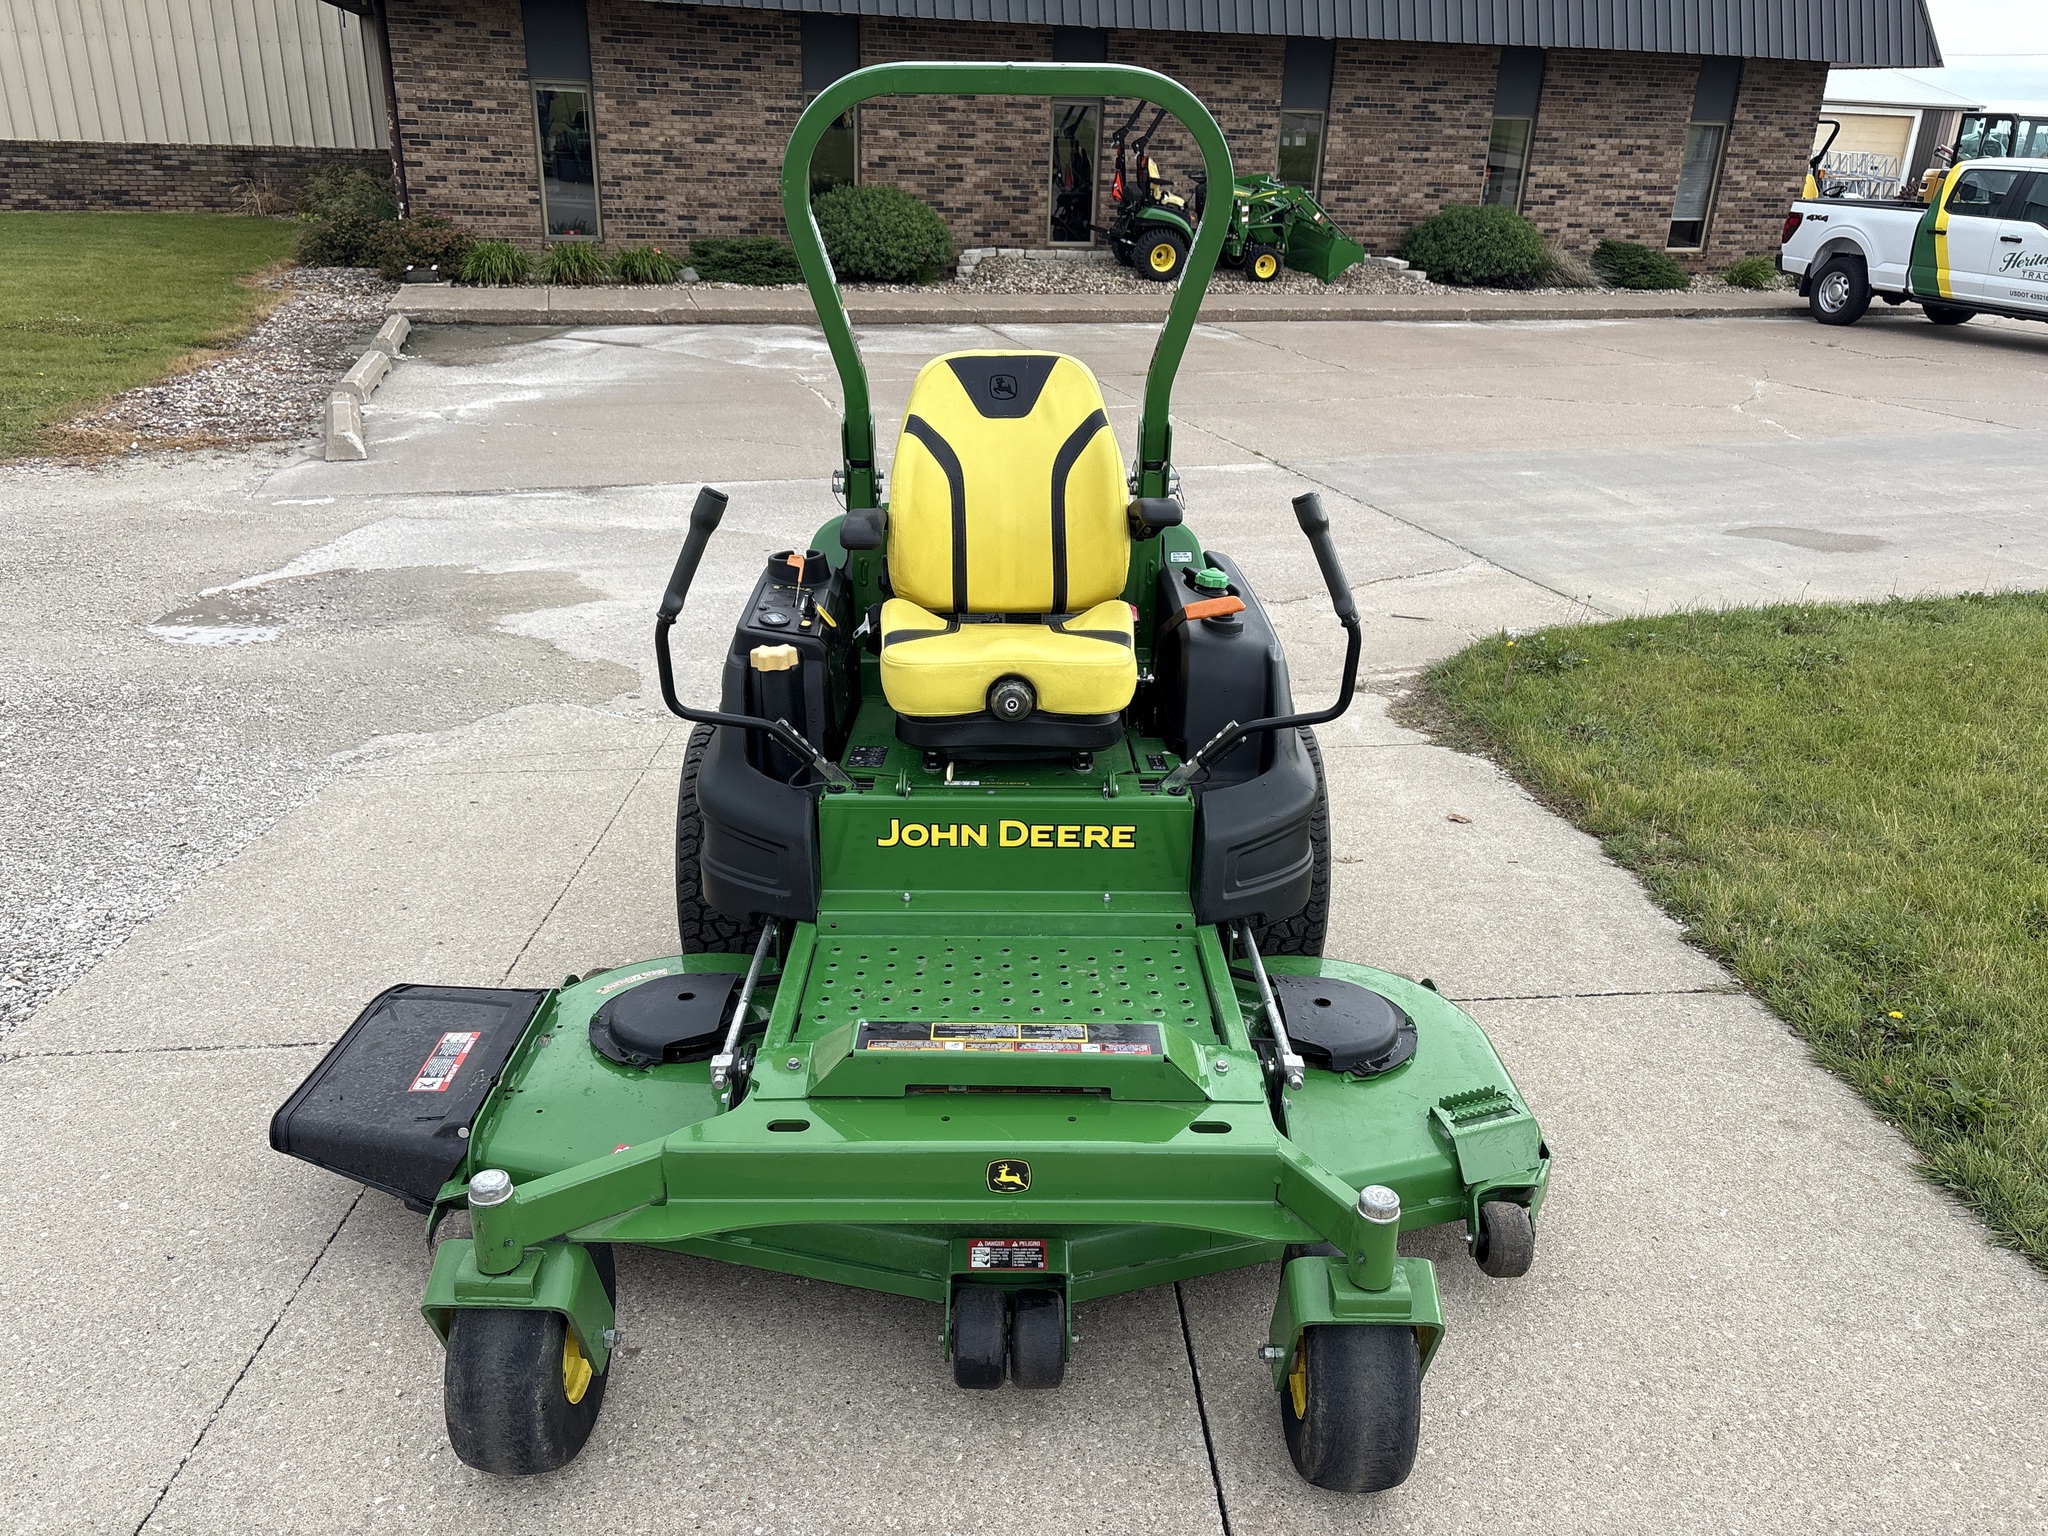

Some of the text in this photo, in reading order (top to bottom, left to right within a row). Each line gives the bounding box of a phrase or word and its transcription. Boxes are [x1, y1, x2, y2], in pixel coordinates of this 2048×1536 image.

[1999, 250, 2048, 272] Herita
[2009, 290, 2029, 299] USDOT
[877, 818, 1137, 849] JOHN DEERE
